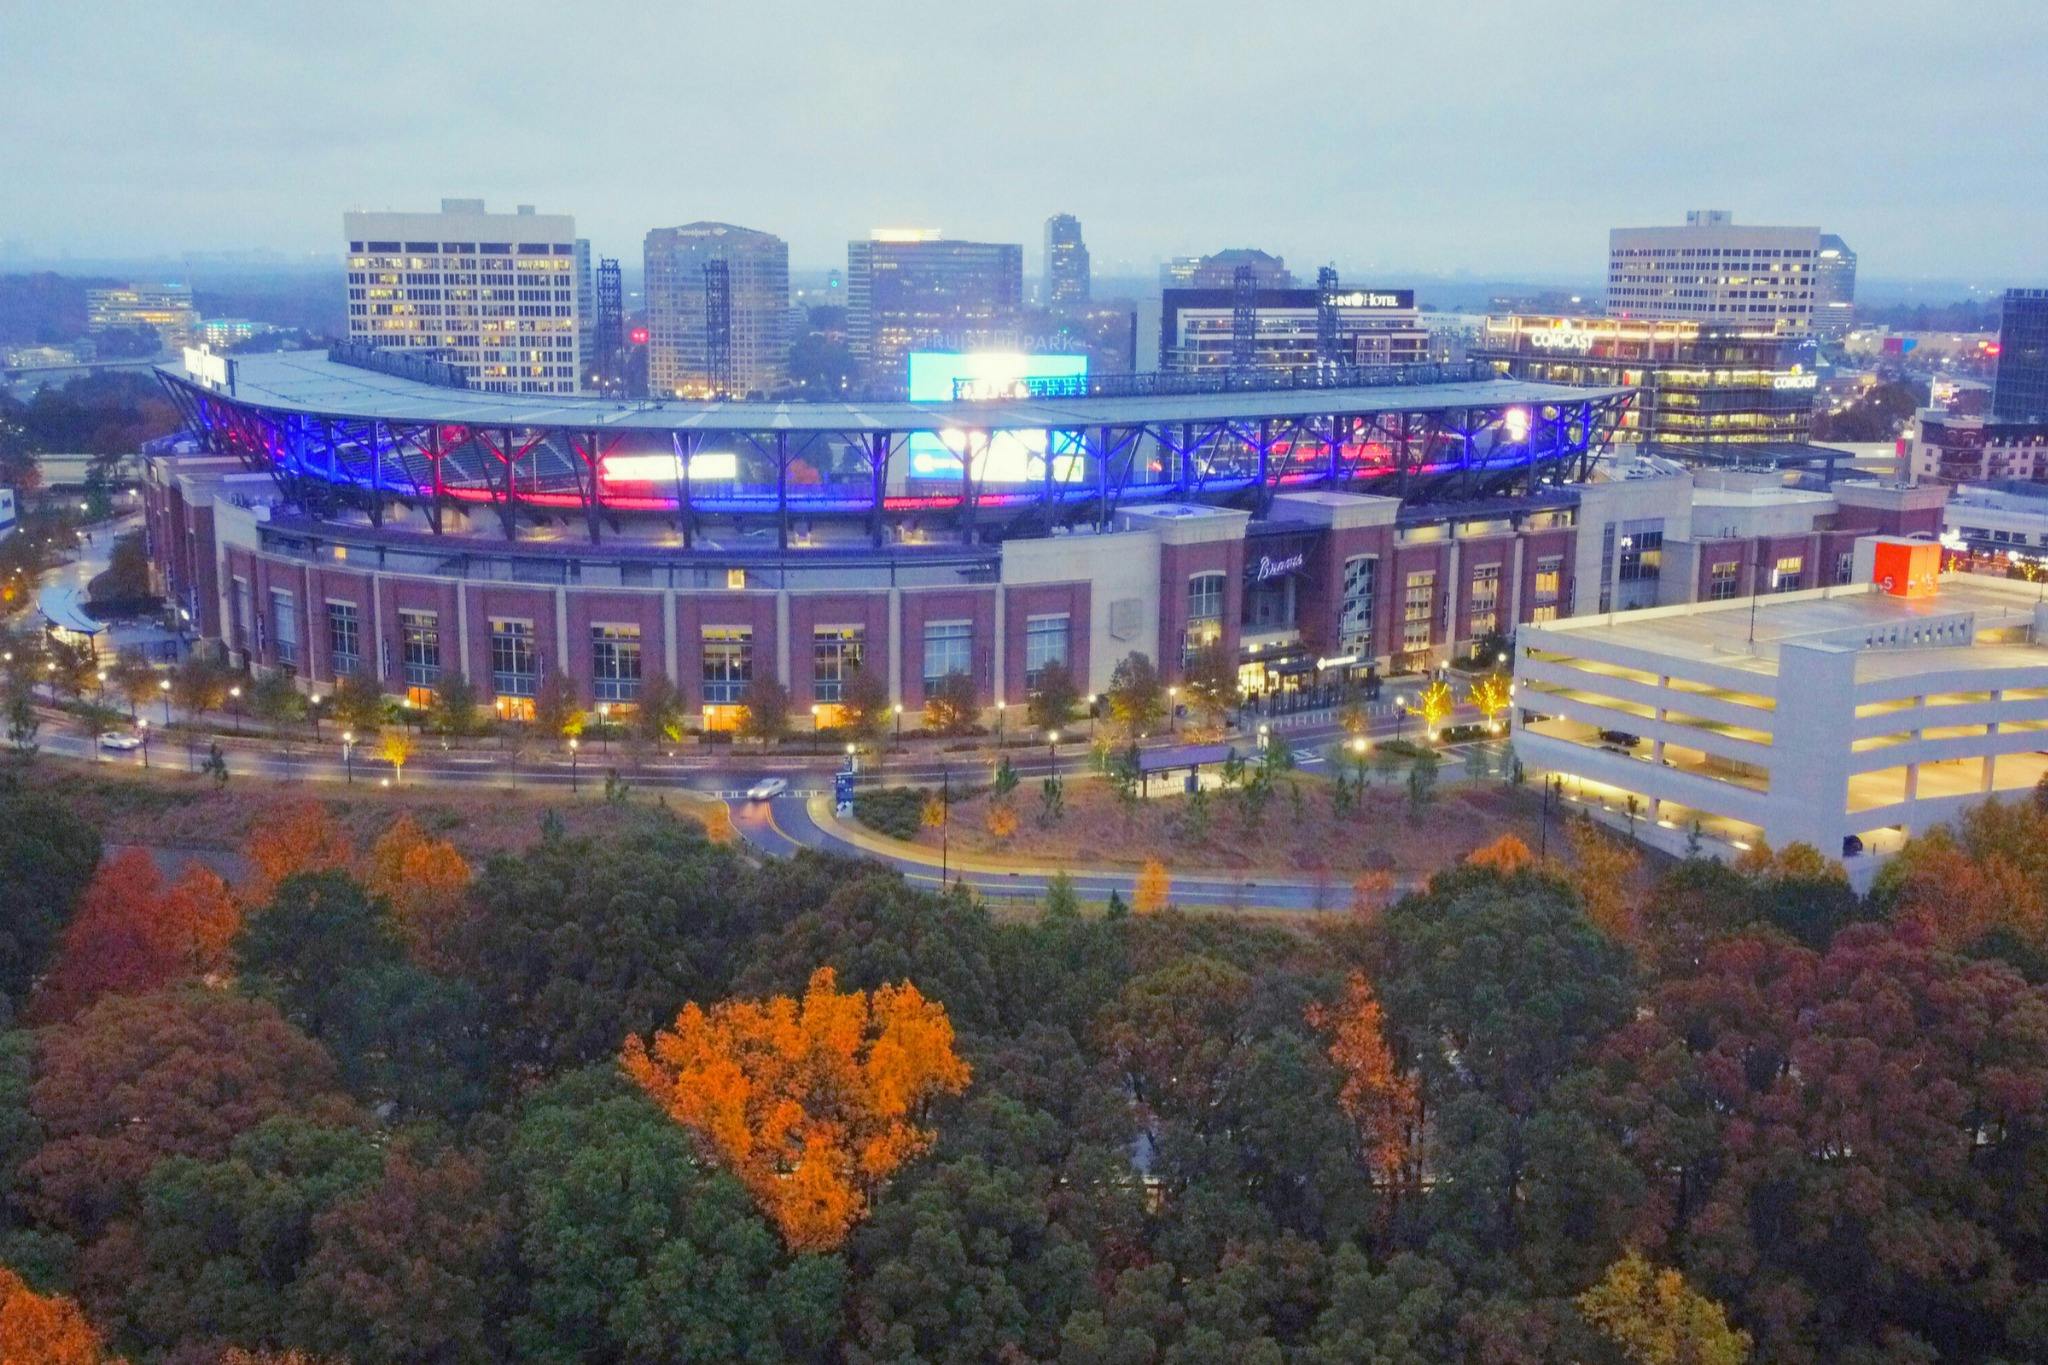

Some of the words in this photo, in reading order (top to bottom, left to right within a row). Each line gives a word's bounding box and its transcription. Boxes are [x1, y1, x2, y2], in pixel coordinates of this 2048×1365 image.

[1363, 292, 1398, 307] HOTEL
[920, 333, 988, 349] TRUIST
[1023, 335, 1074, 351] PARK
[1531, 333, 1593, 349] COMCAST
[1774, 375, 1818, 389] COMCAST
[1257, 553, 1303, 582] Braves
[1884, 576, 1893, 590] 5
